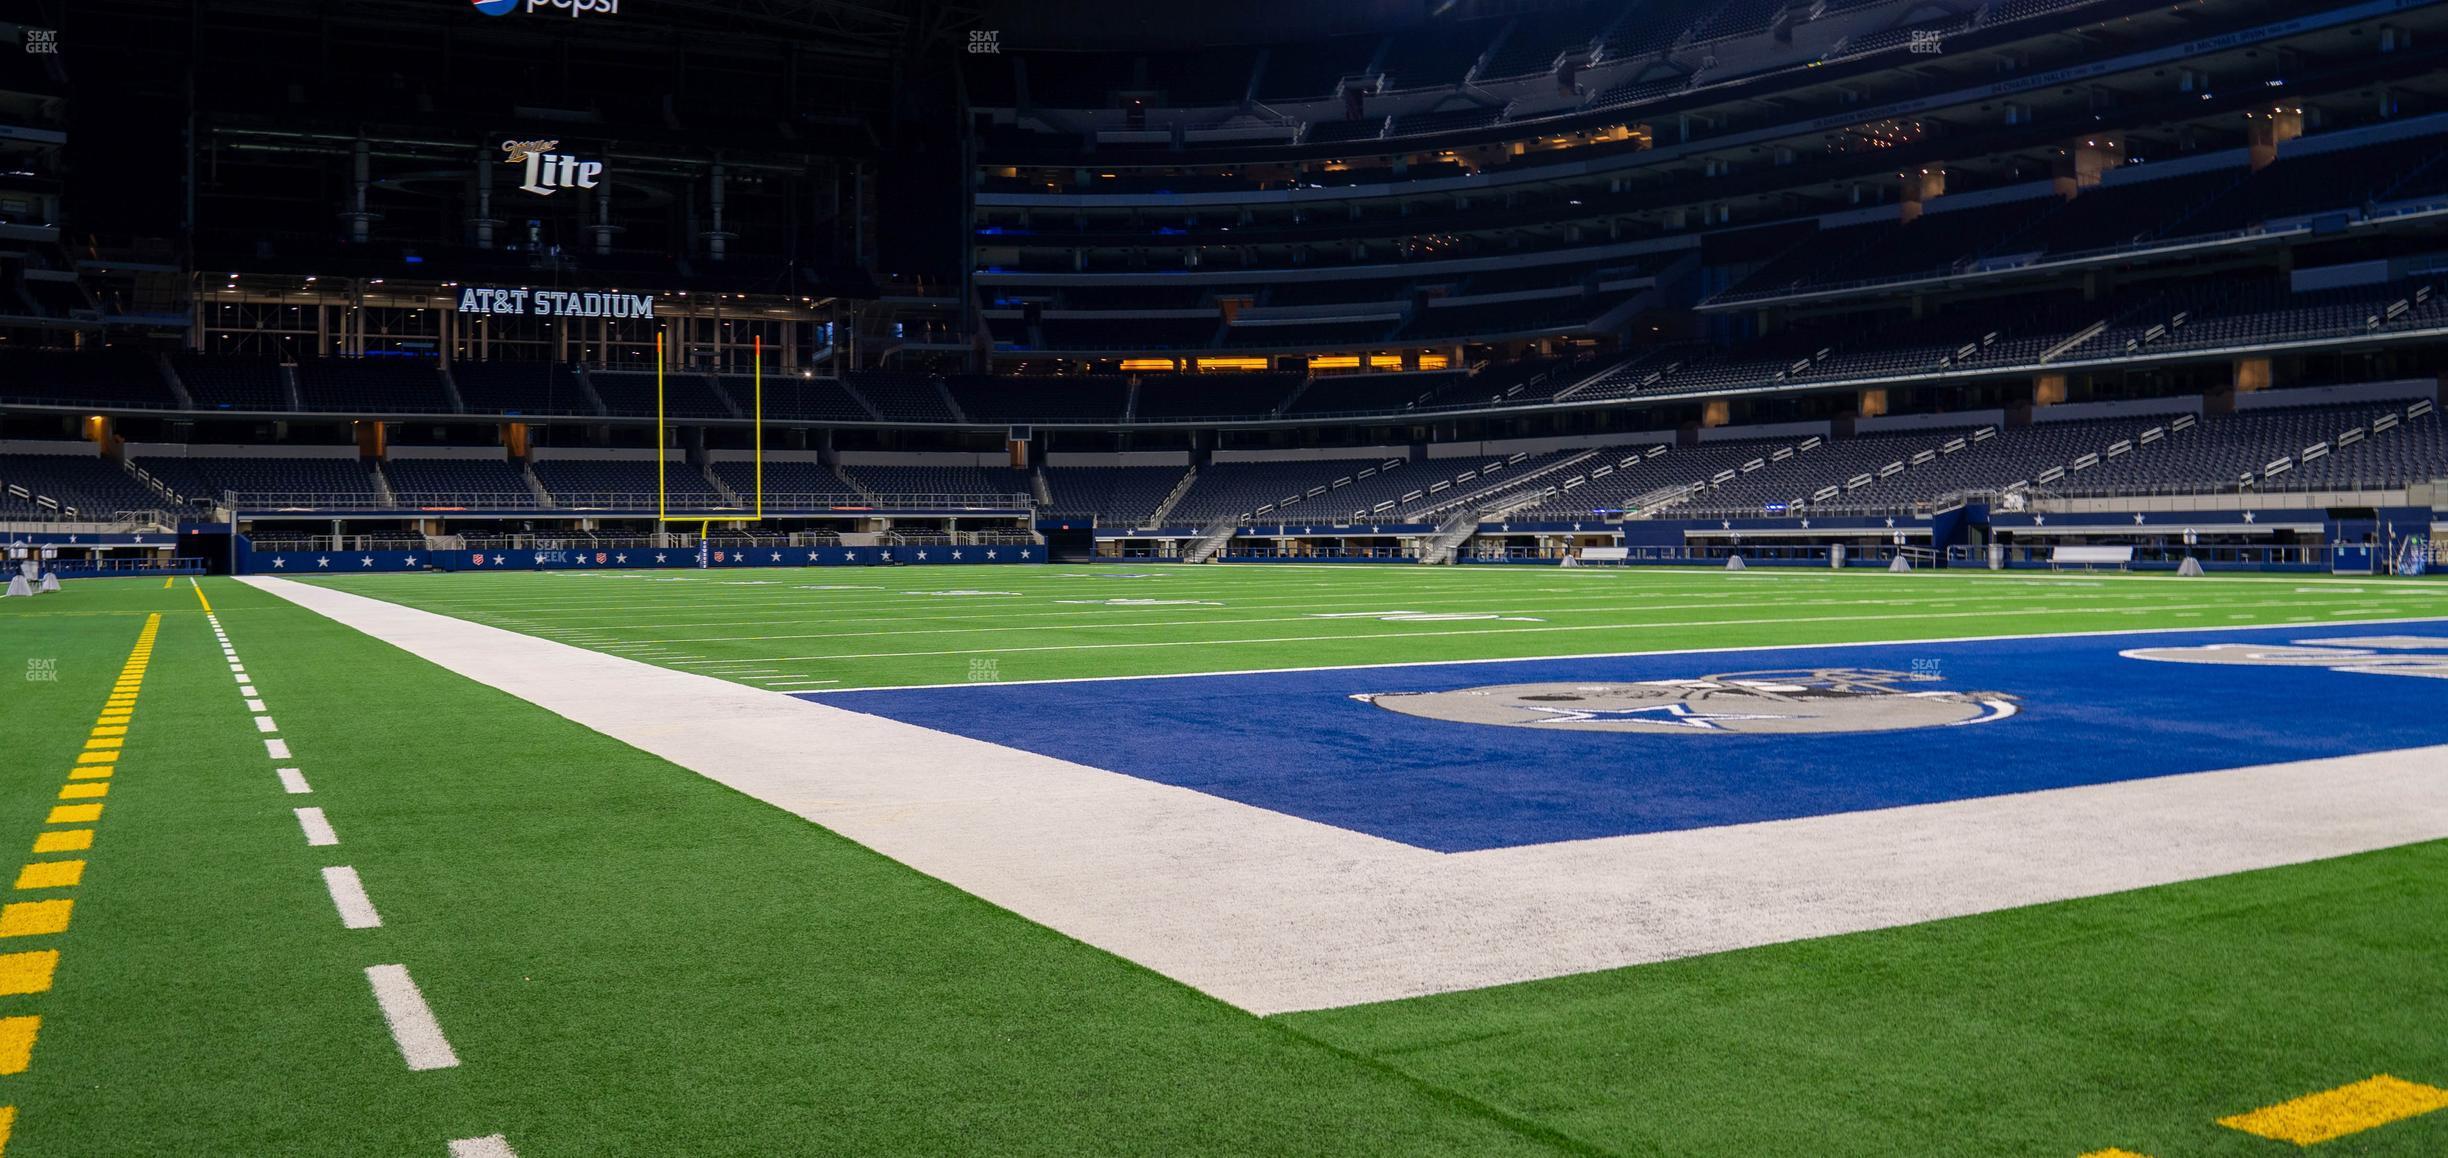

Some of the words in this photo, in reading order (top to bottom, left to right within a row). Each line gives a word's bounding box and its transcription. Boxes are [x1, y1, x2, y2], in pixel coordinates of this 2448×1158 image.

[501, 139, 559, 163] Miller
[519, 151, 603, 196] Lite
[459, 288, 528, 314] AT&T
[534, 291, 654, 319] STADIUM
